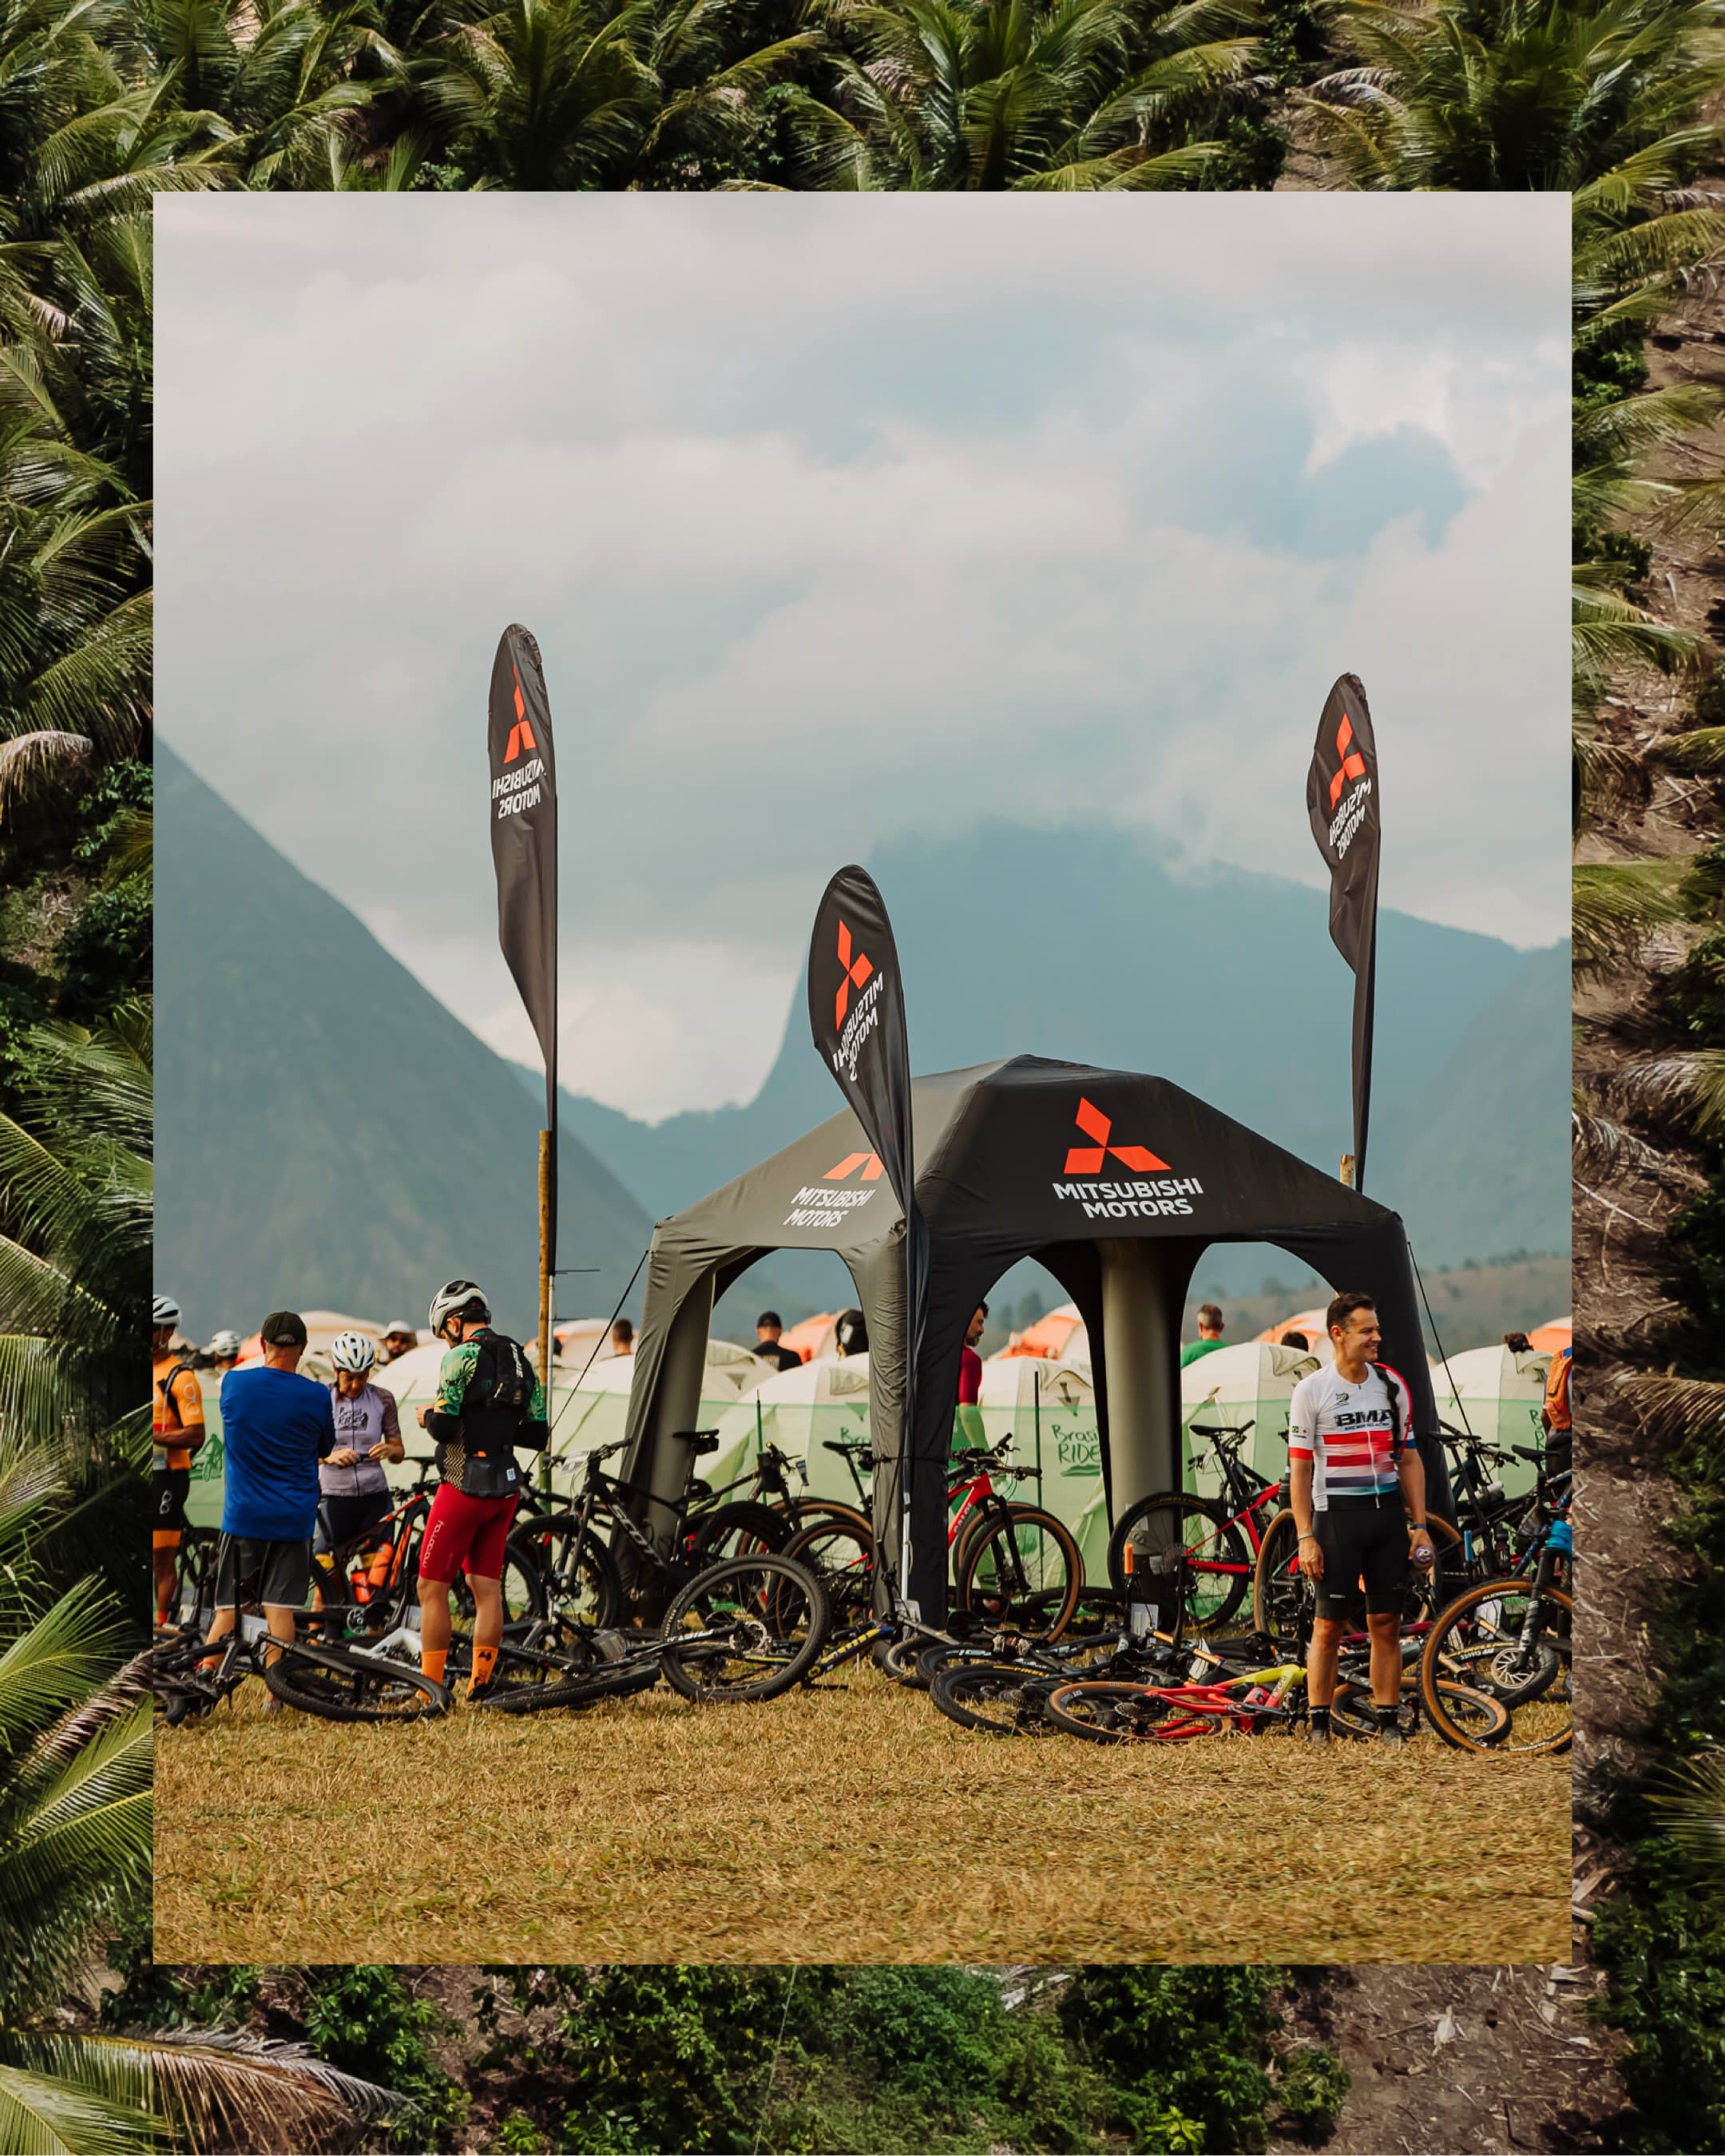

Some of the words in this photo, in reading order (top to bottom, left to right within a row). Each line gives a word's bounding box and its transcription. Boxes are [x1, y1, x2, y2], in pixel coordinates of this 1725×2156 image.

[791, 1187, 876, 1207] MITSUBISHI
[1052, 1178, 1204, 1199] MITSUBISHI
[783, 1208, 849, 1227] MOTORS
[1081, 1198, 1194, 1219] MOTORS
[1051, 1425, 1099, 1444] Brasi
[1058, 1443, 1100, 1464] RIDE
